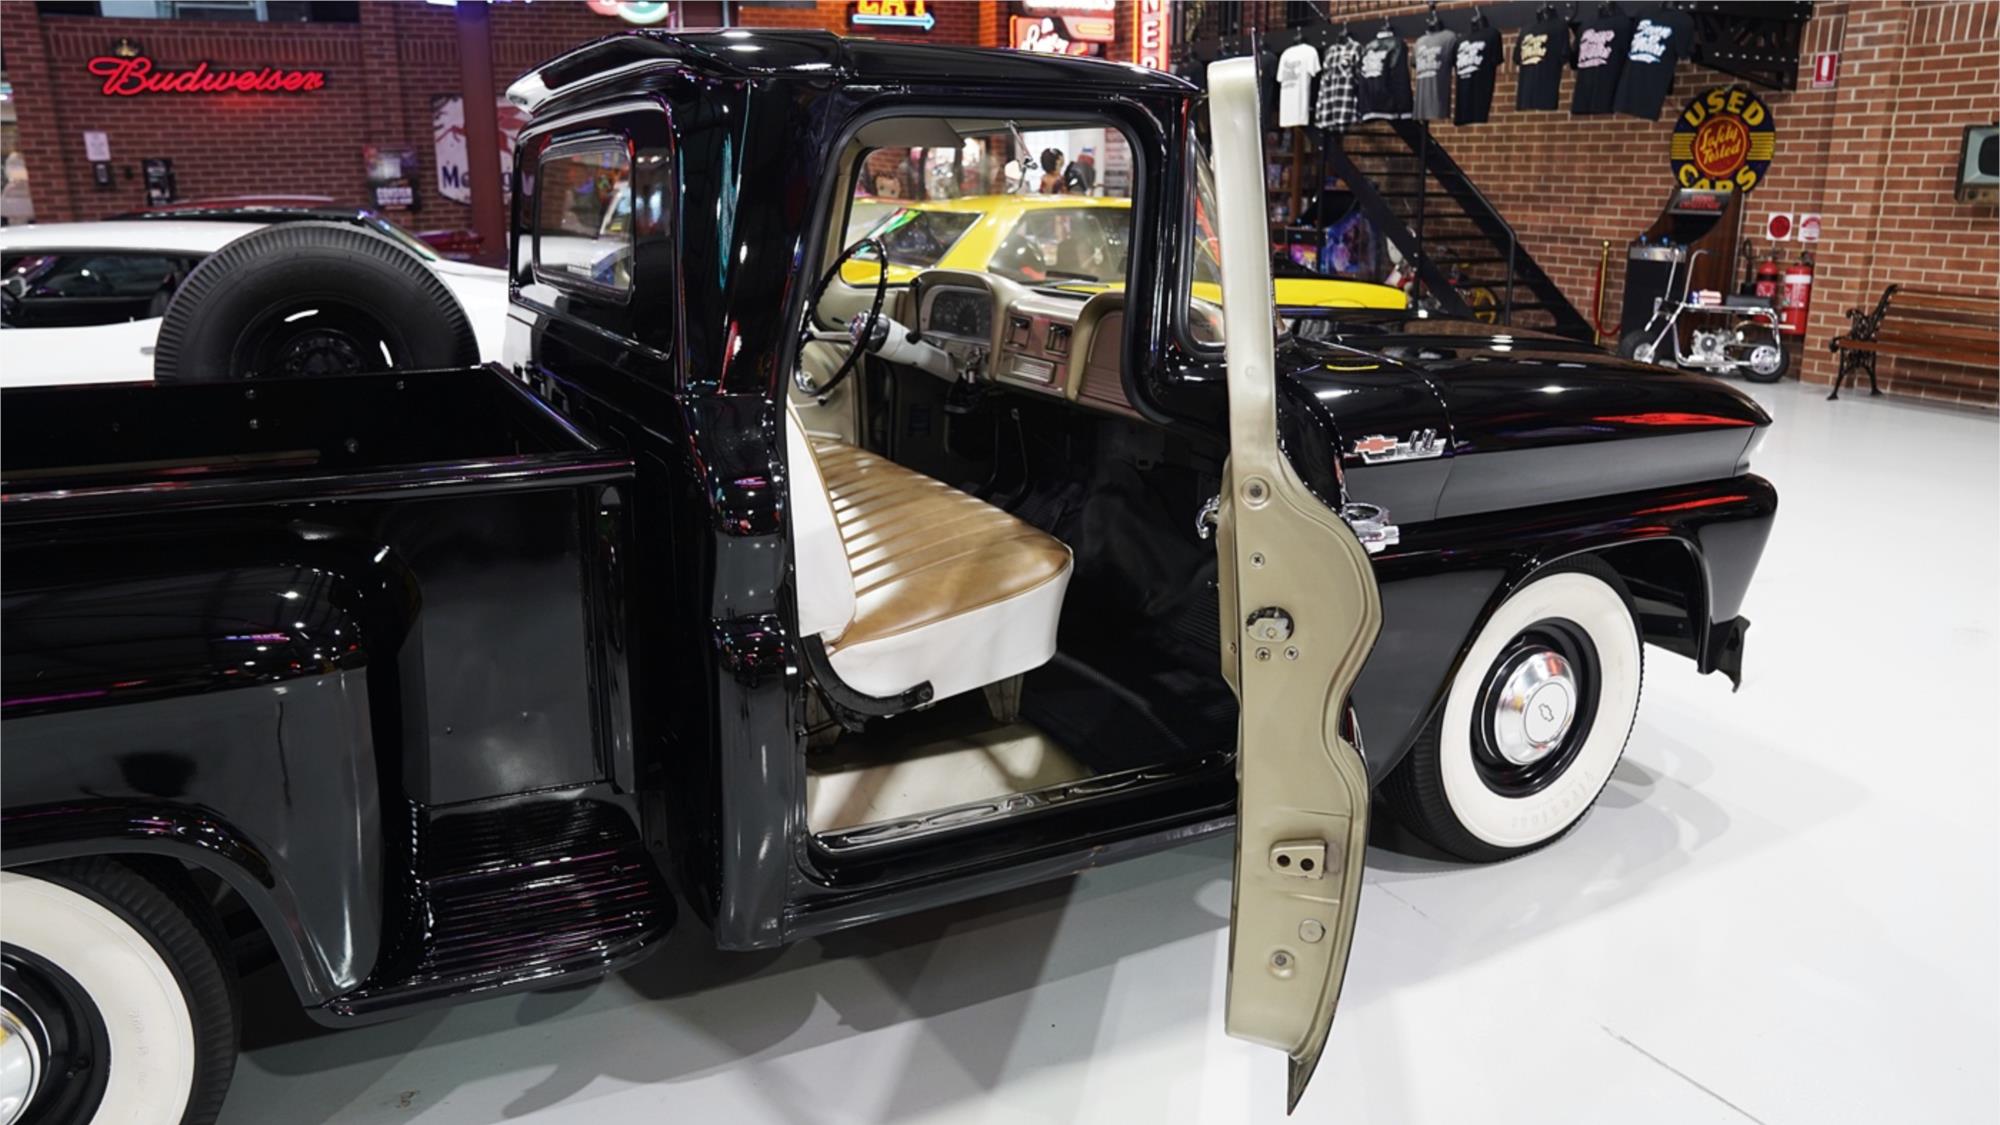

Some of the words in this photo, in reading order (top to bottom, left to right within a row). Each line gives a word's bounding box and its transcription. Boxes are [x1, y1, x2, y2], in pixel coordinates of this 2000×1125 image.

[88, 56, 324, 95] Budweiser
[1684, 89, 1765, 128] USED
[1700, 123, 1739, 150] Safety
[1702, 138, 1741, 165] Tested
